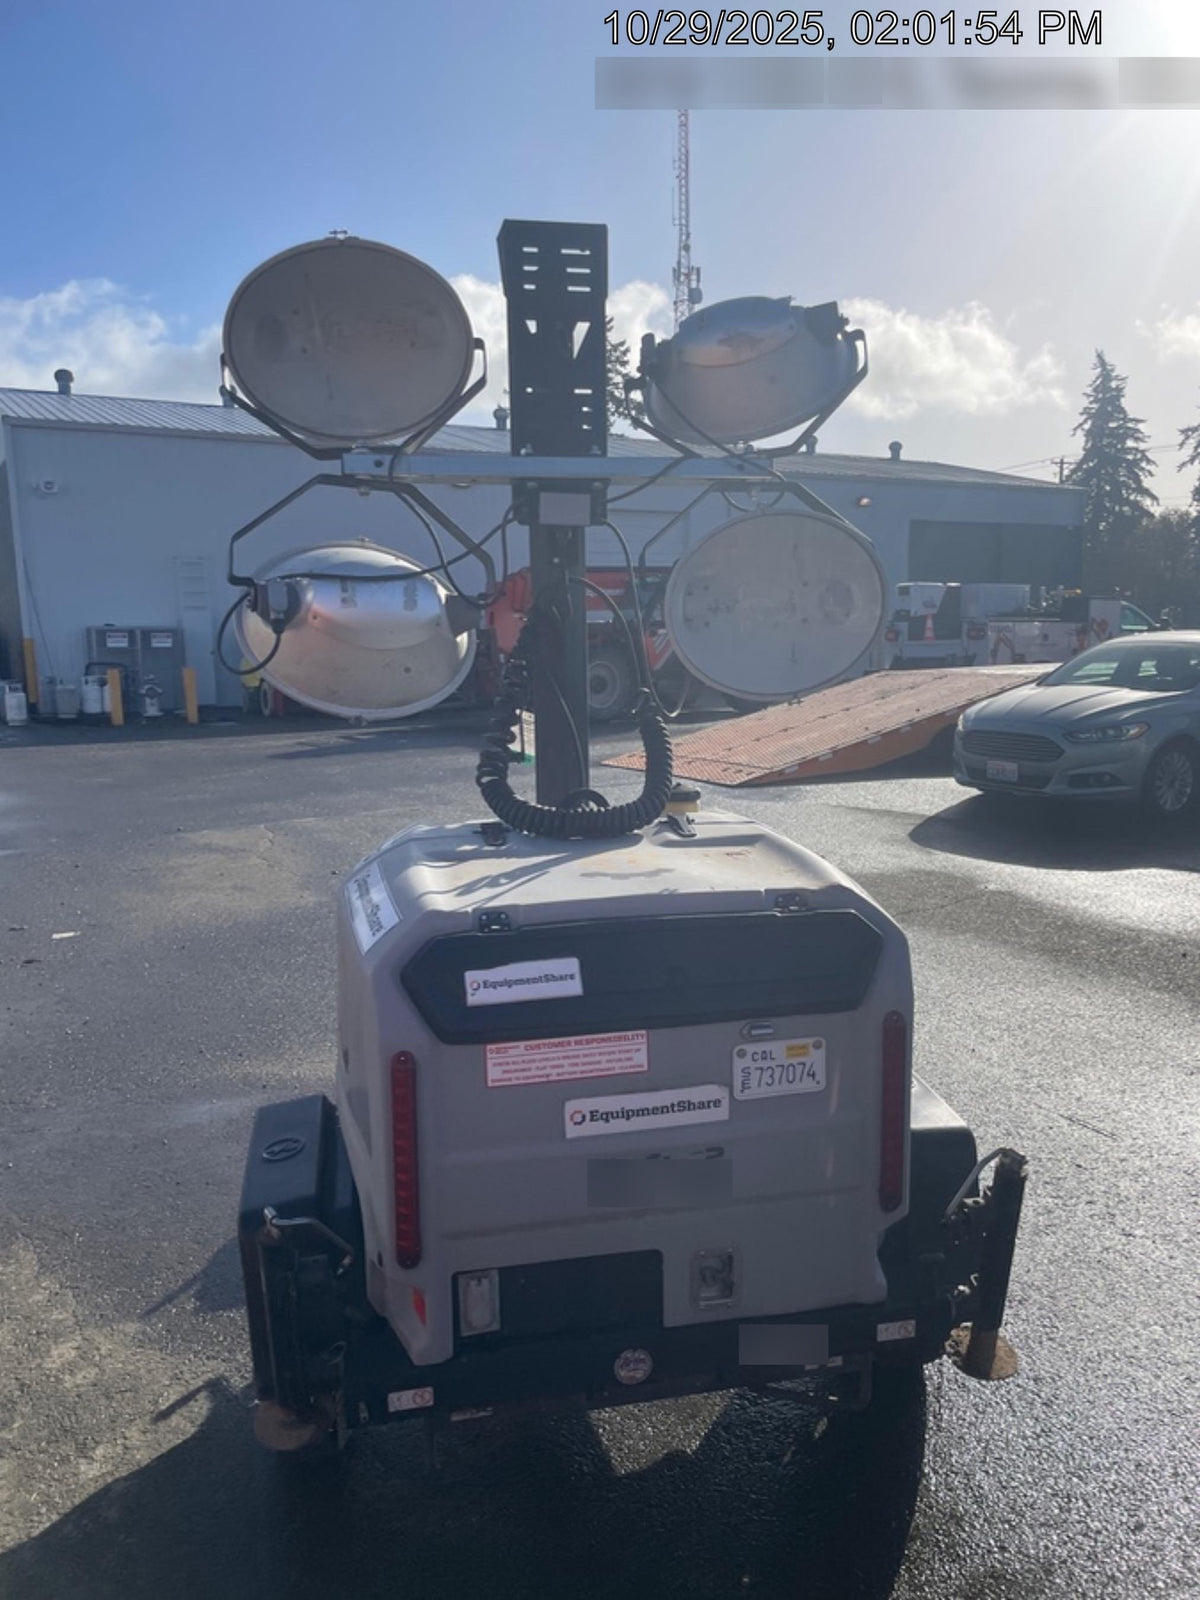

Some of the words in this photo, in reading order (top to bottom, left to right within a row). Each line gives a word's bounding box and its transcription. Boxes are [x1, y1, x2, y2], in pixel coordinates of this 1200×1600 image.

[481, 971, 576, 990] EquipmentShare
[524, 1038, 572, 1052] CUSTOMER
[574, 1032, 646, 1047] RESPONSIBILITY
[751, 1050, 776, 1062] CAL
[754, 1062, 816, 1088] 737074
[589, 1097, 722, 1123] EquipmentShare
